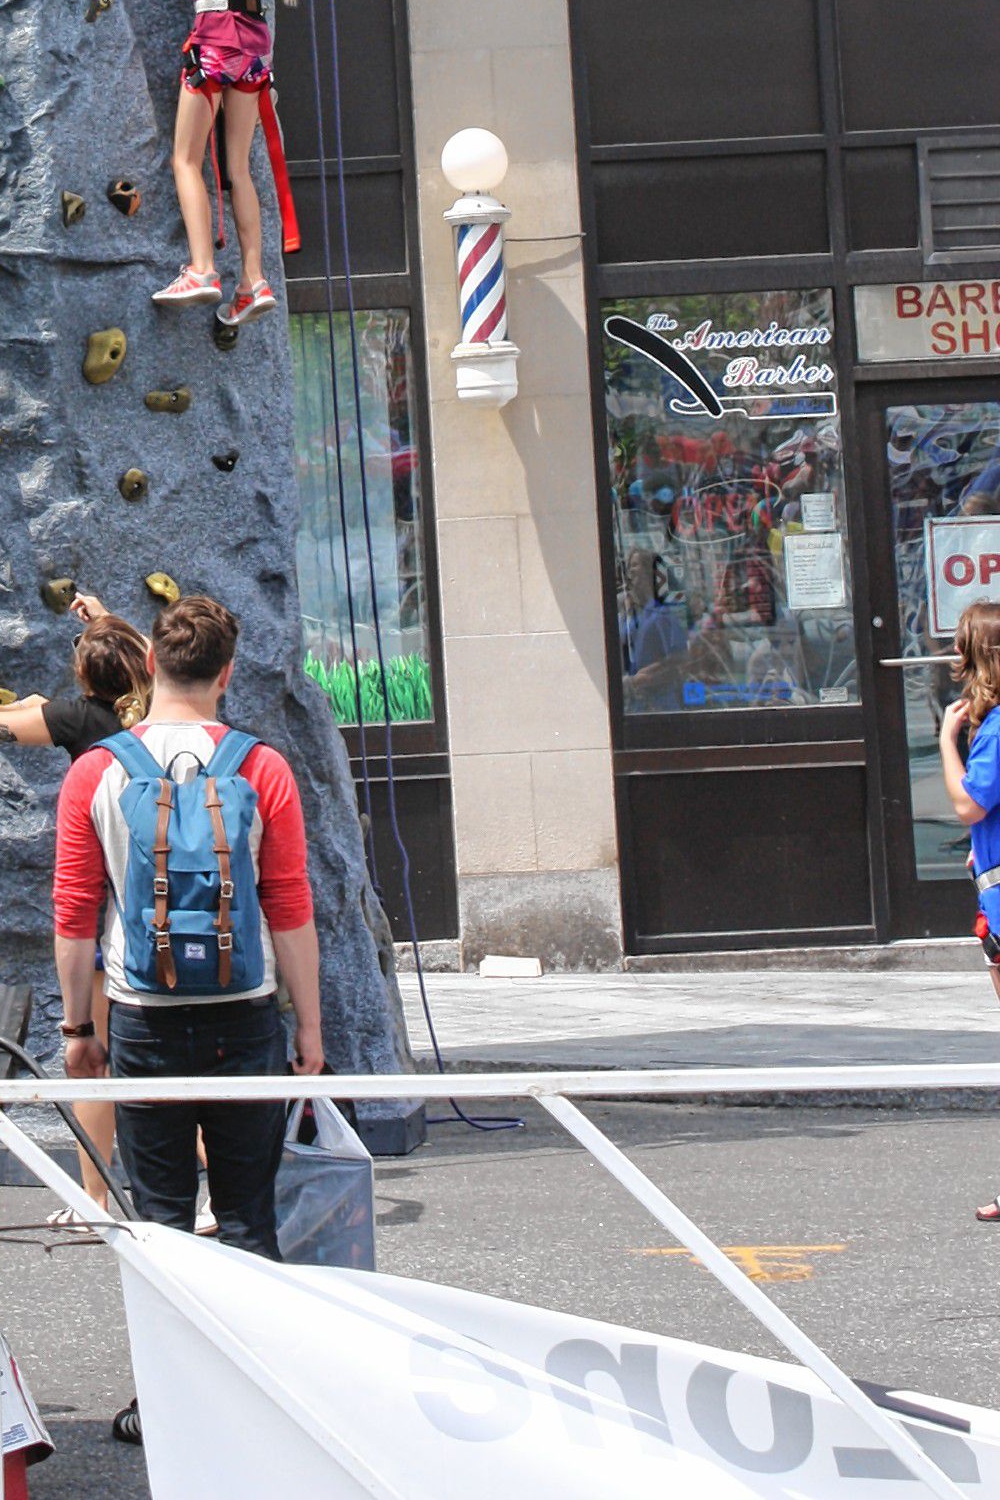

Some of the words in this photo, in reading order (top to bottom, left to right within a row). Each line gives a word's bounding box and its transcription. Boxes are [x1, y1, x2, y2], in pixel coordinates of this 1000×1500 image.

[648, 313, 677, 331] The
[673, 320, 832, 351] American
[931, 320, 1000, 355] SH
[723, 354, 834, 387] Barber
